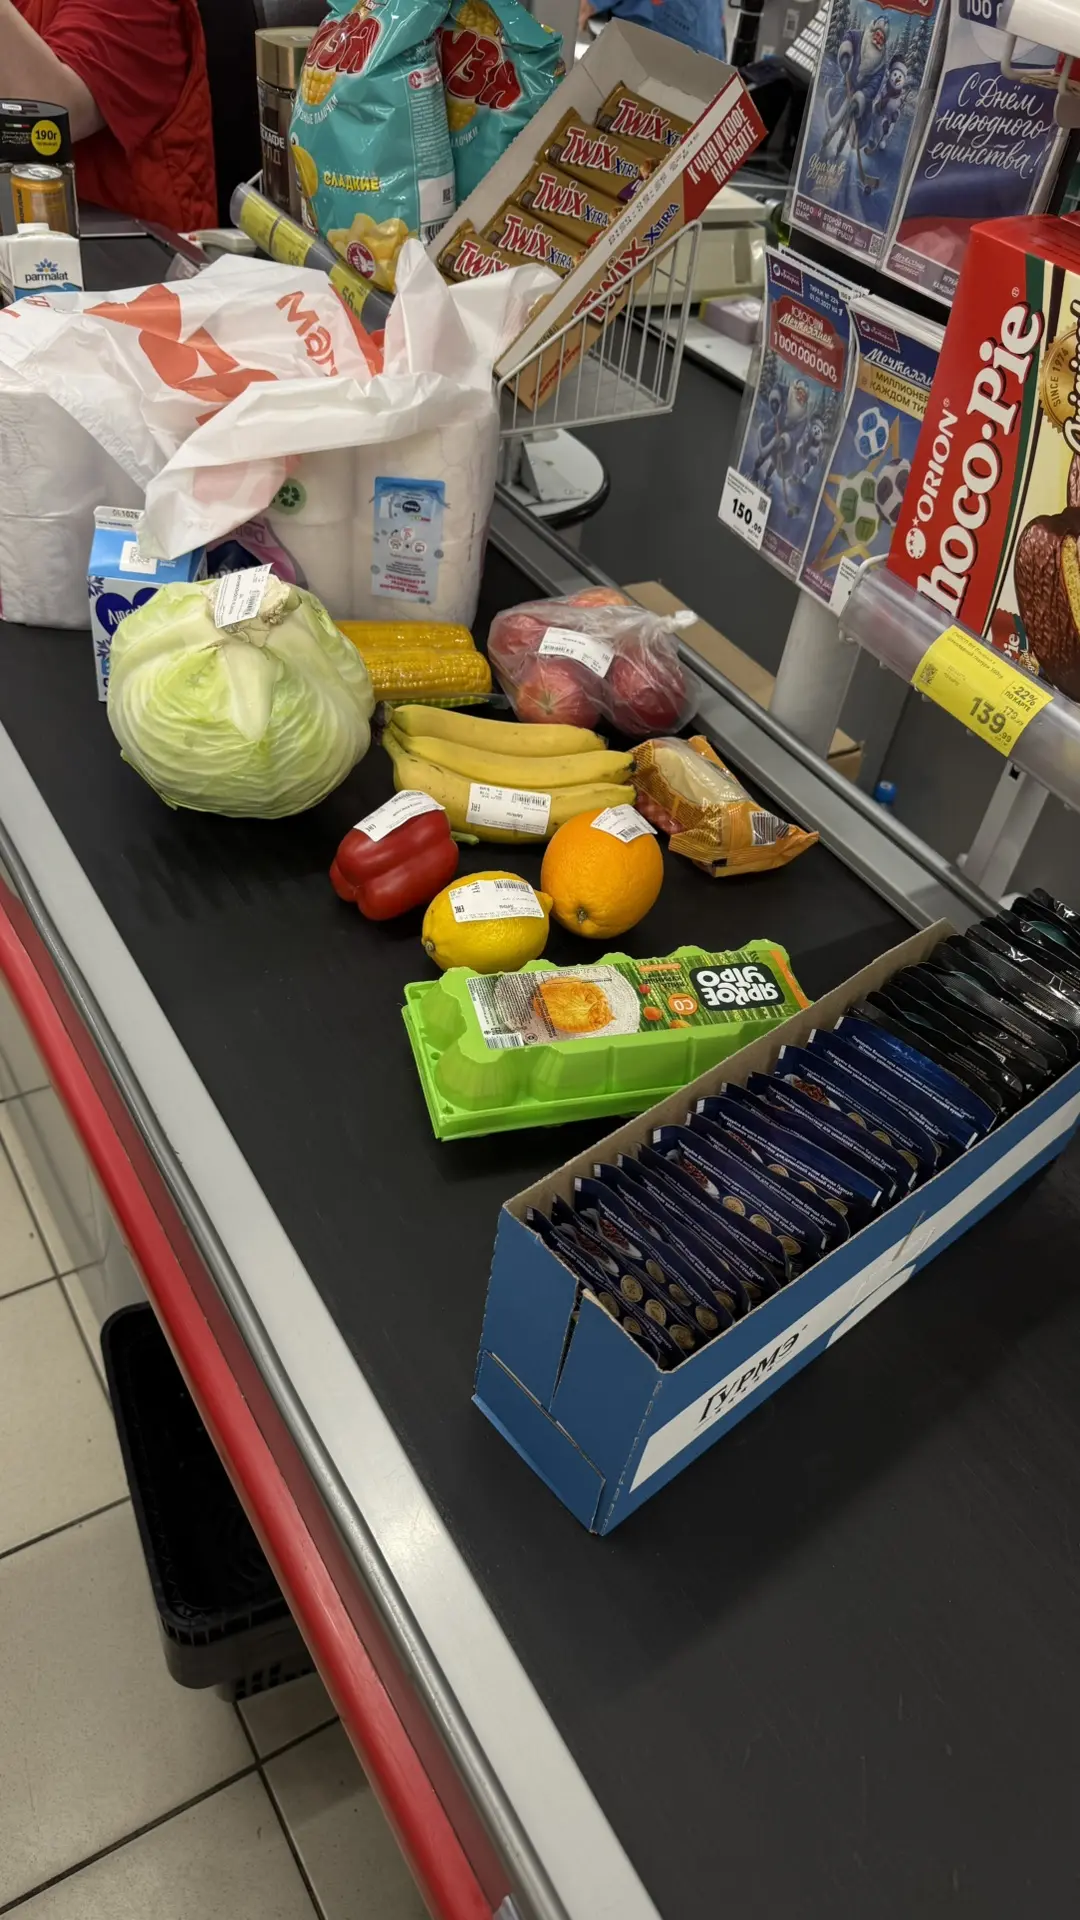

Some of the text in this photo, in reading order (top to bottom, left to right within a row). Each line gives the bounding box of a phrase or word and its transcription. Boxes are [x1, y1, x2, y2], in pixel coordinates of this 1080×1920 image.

[958, 71, 1045, 117] С Днём
[686, 101, 749, 185] К ЧАЮ И КОФЕ
[935, 109, 1051, 149] народного
[710, 119, 759, 186] НА РАБОТЕ
[924, 139, 1052, 180] единства!
[323, 170, 380, 192] СЛАДКИЕ
[25, 272, 69, 284] parmalat
[864, 347, 934, 386] Мечталли
[1050, 347, 1070, 408] SINCE 1974
[870, 380, 911, 406] КАЖДОМ
[917, 408, 959, 523] ORION
[1004, 691, 1031, 713] ПО КАРТЕ
[1011, 684, 1038, 707] -22%
[696, 965, 766, 989] УТРО
[701, 981, 779, 1007] ЯРКОЕ
[699, 1332, 800, 1422] ГУРМЭ
